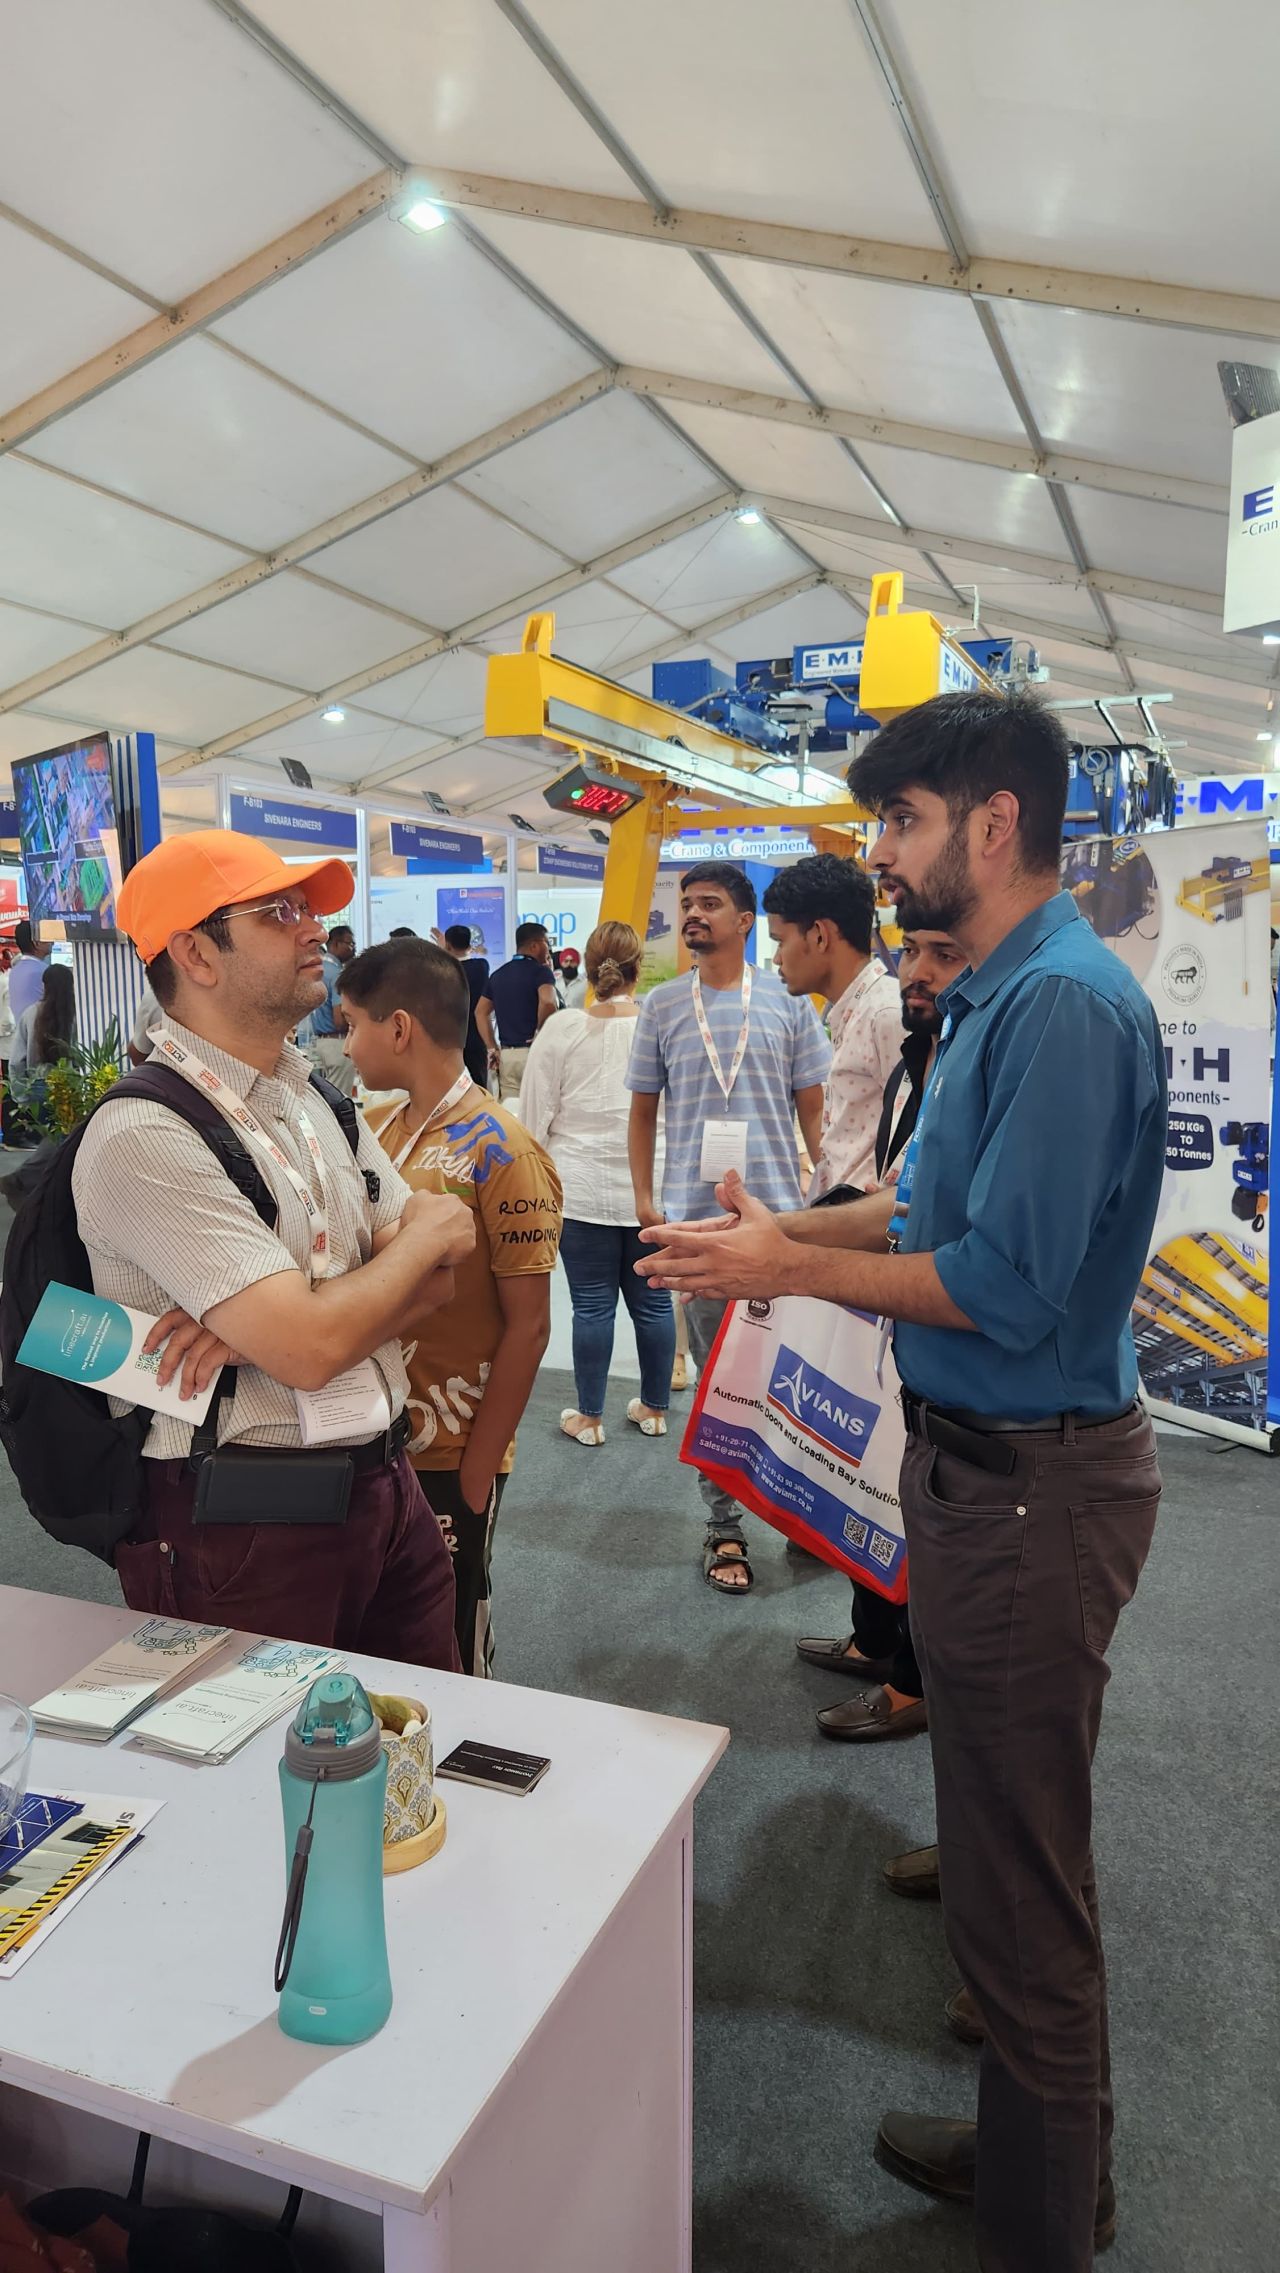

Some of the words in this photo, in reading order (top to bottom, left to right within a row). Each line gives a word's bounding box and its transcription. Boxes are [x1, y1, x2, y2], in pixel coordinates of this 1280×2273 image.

[264, 813, 291, 827] SIVENARA
[292, 818, 322, 832] ENGINEERS
[1183, 1020, 1197, 1035] to
[1186, 1122, 1205, 1133] KGs
[1180, 1135, 1194, 1145] TO
[1179, 1148, 1212, 1161] Tonnes
[500, 1199, 557, 1214] ROYALS
[751, 1300, 767, 1310] ISO
[774, 1362, 865, 1436] AVIANS
[714, 1386, 764, 1412] Automatic
[765, 1407, 783, 1431] Doors
[784, 1429, 798, 1445] and
[799, 1440, 835, 1473] Loading
[838, 1467, 856, 1486] Bay
